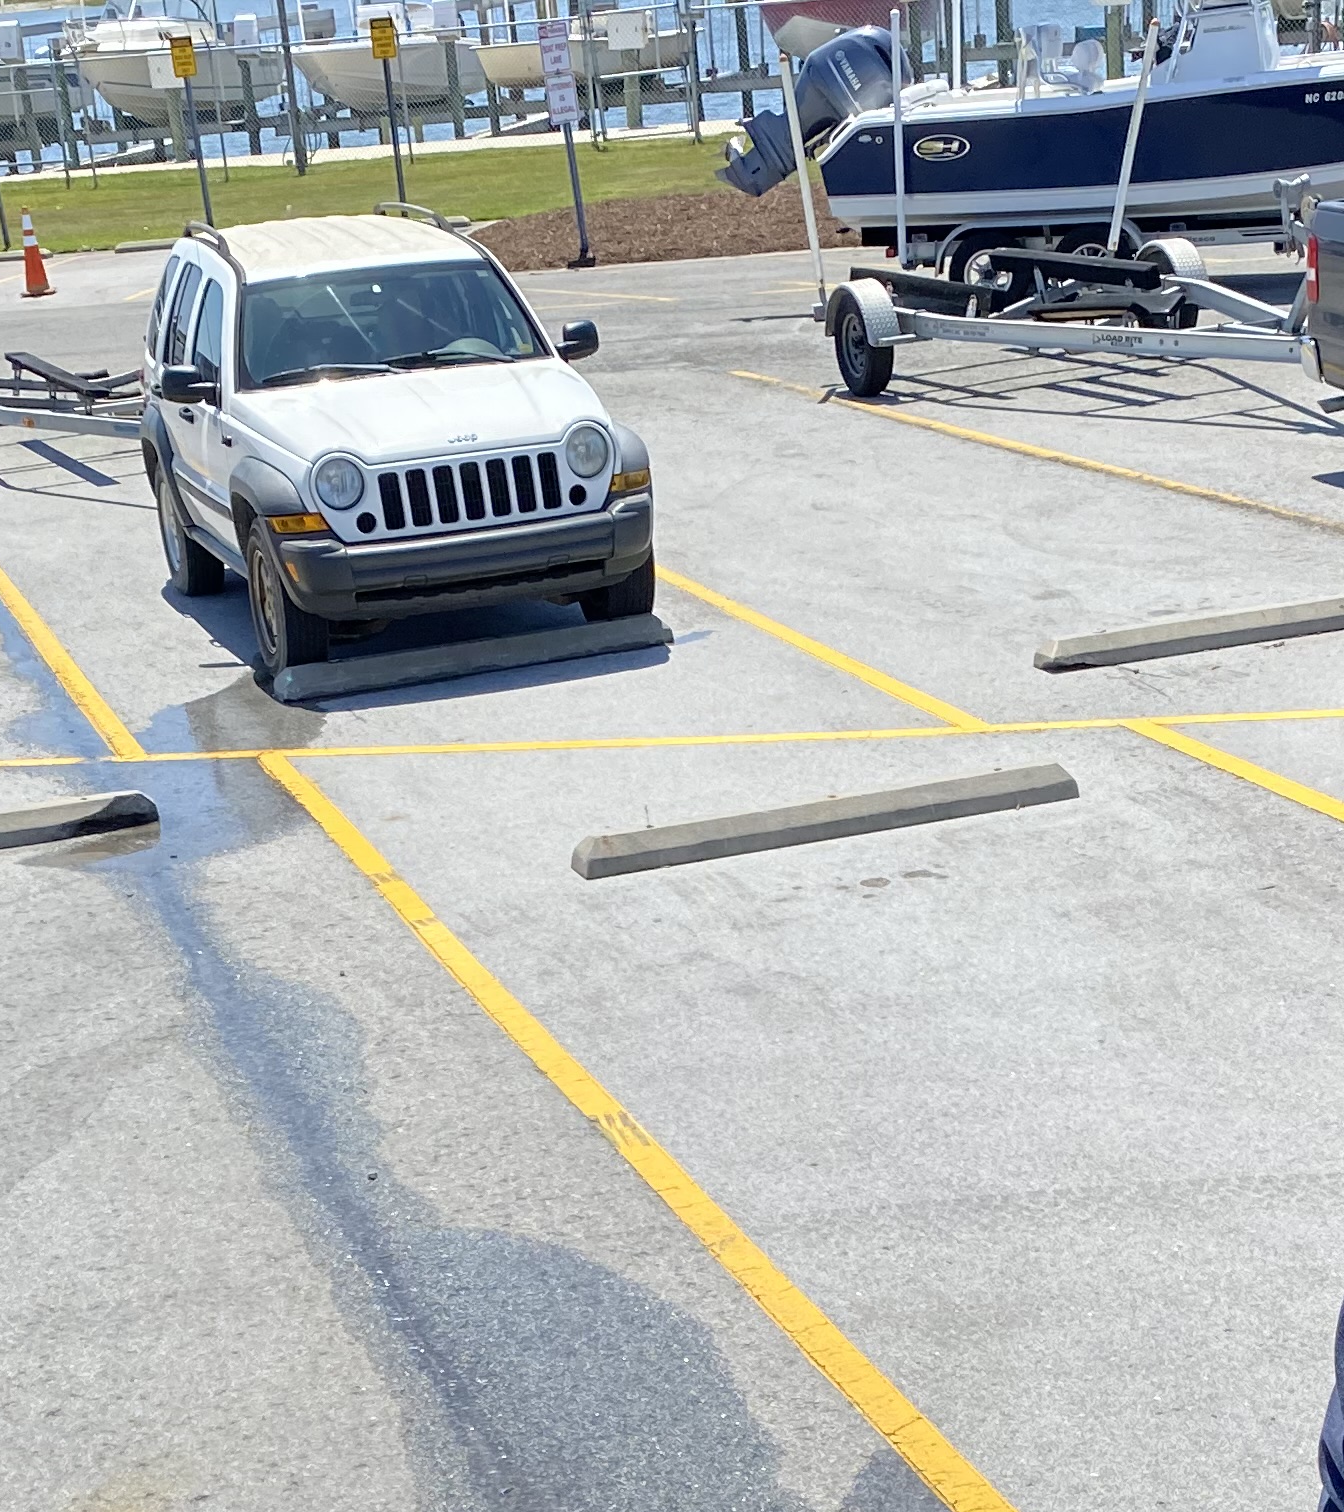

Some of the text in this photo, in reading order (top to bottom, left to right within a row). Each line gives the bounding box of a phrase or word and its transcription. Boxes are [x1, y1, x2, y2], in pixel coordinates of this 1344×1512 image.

[550, 55, 563, 65] LANE
[840, 58, 862, 91] YAMAHA
[1101, 333, 1124, 343] LOAD
